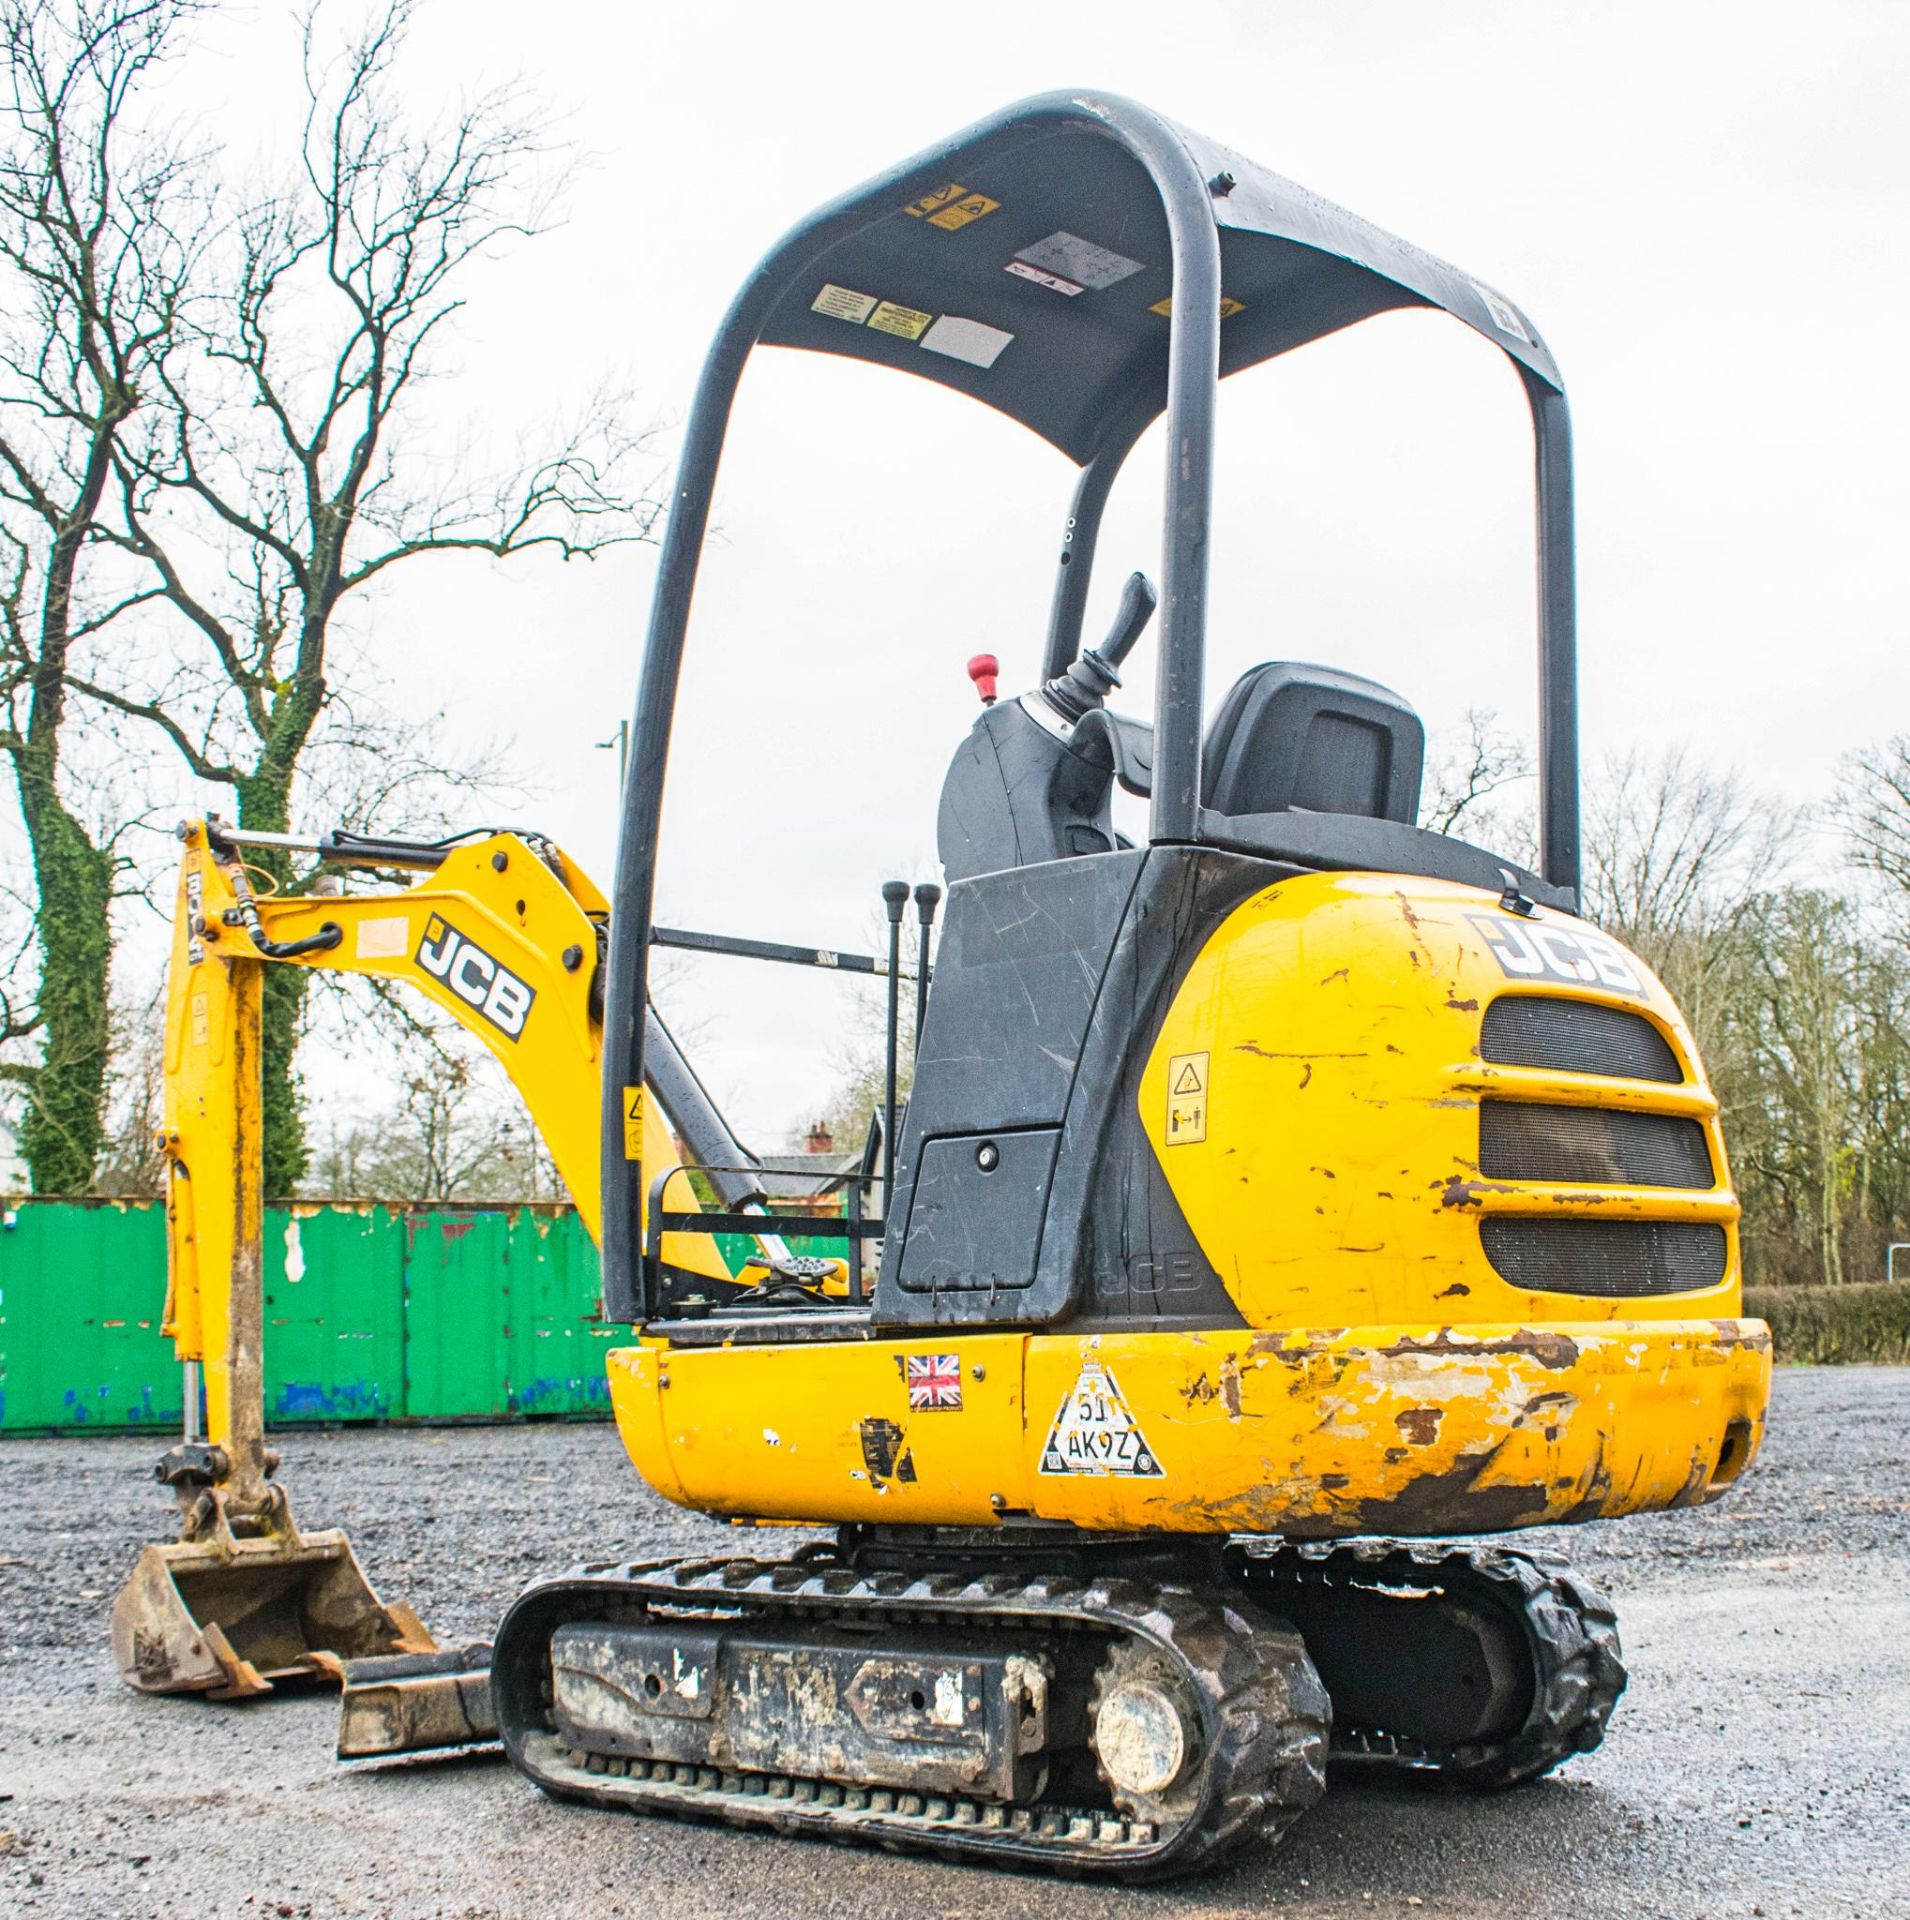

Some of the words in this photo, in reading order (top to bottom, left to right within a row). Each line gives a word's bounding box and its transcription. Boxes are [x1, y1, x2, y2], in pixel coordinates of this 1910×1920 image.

[420, 931, 531, 1034] JCB
[1493, 919, 1642, 992] JCB
[1068, 1431, 1132, 1460] AK9Z
